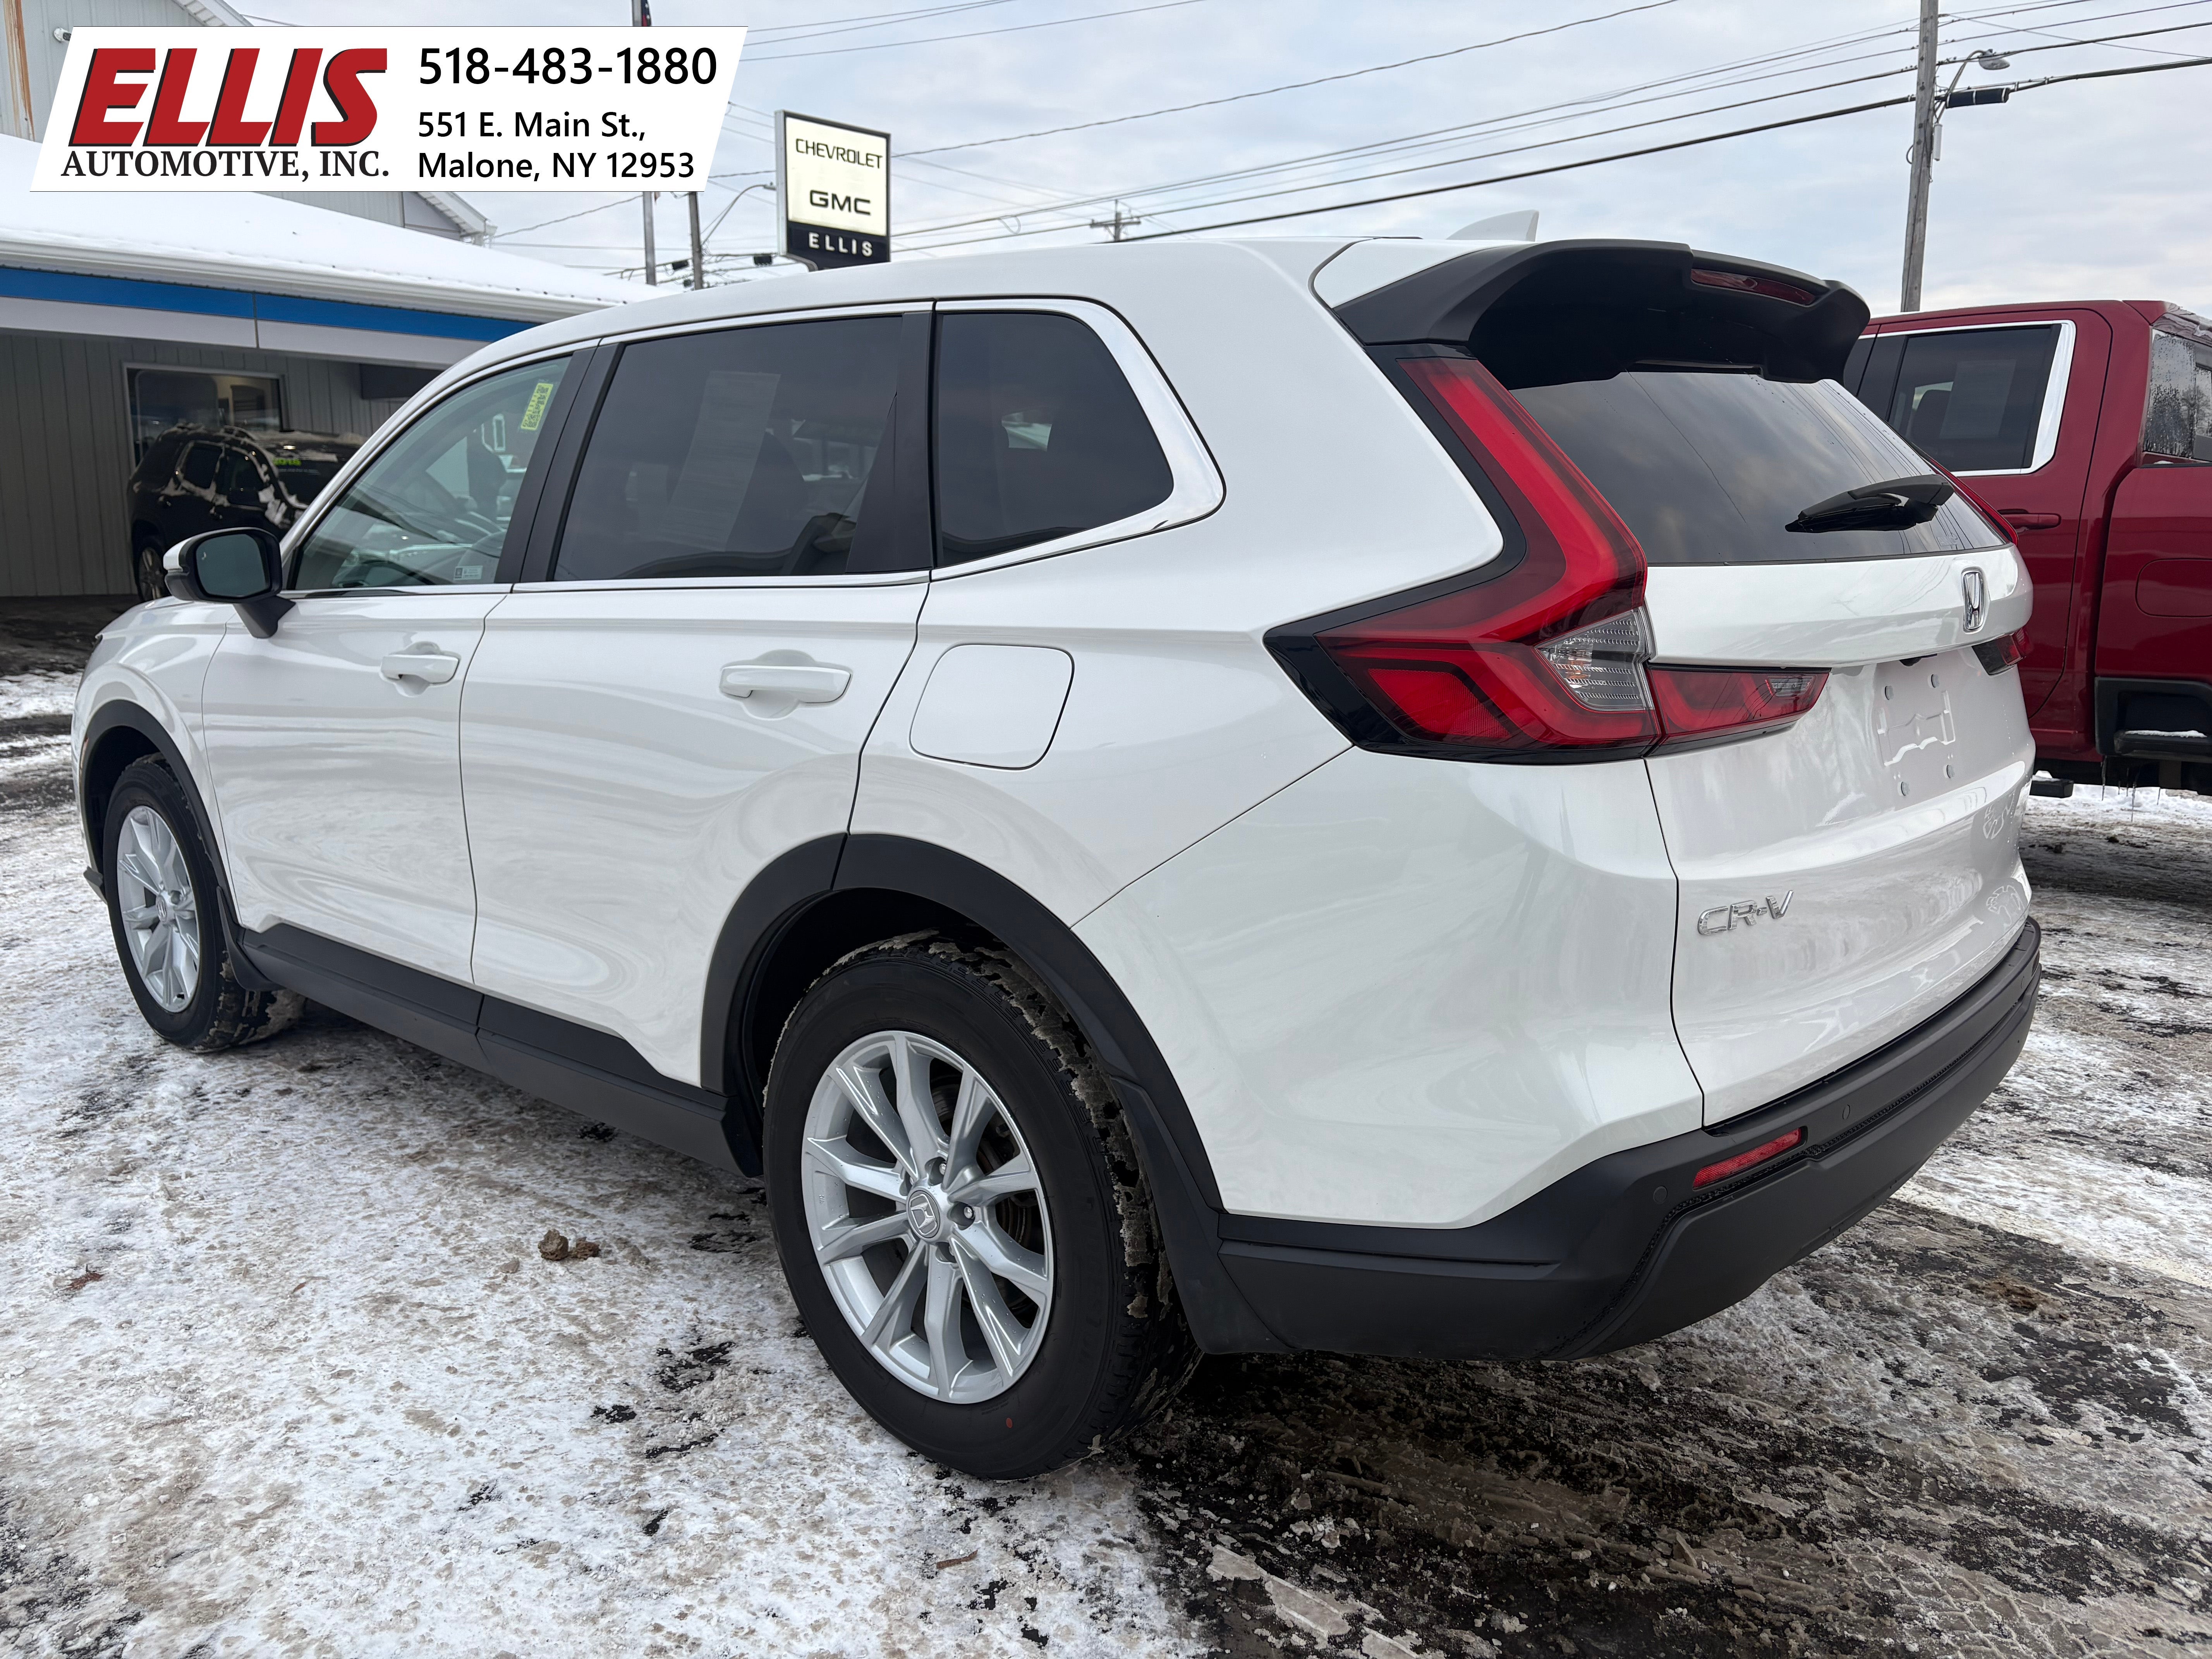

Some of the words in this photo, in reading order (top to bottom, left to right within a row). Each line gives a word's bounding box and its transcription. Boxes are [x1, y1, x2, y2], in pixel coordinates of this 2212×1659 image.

[796, 138, 883, 168] CHEVROLET
[810, 190, 871, 215] GMC
[808, 232, 873, 257] ELLIS
[1697, 890, 1795, 935] CR-V
